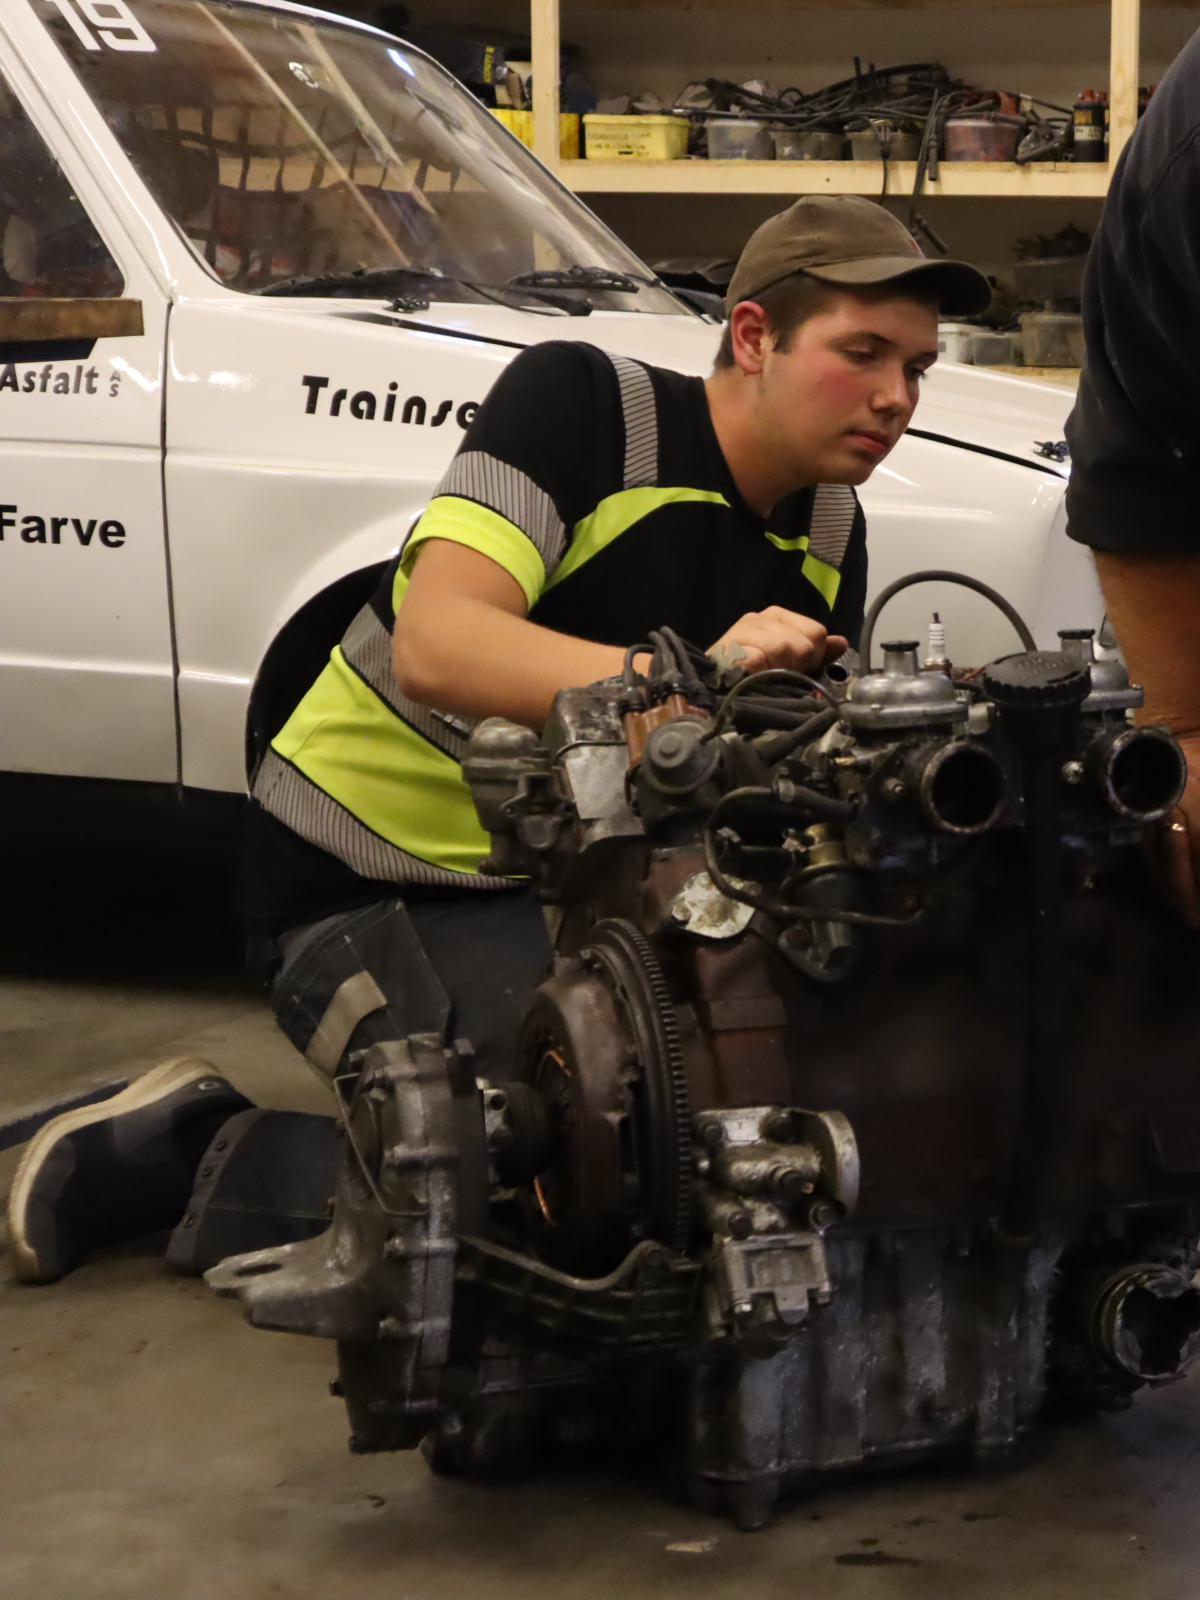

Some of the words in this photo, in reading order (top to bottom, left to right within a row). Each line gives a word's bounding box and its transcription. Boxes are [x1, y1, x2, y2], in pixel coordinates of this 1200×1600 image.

[46, 0, 158, 52] 19
[0, 363, 99, 395] Asfalt
[0, 504, 126, 548] Farve
